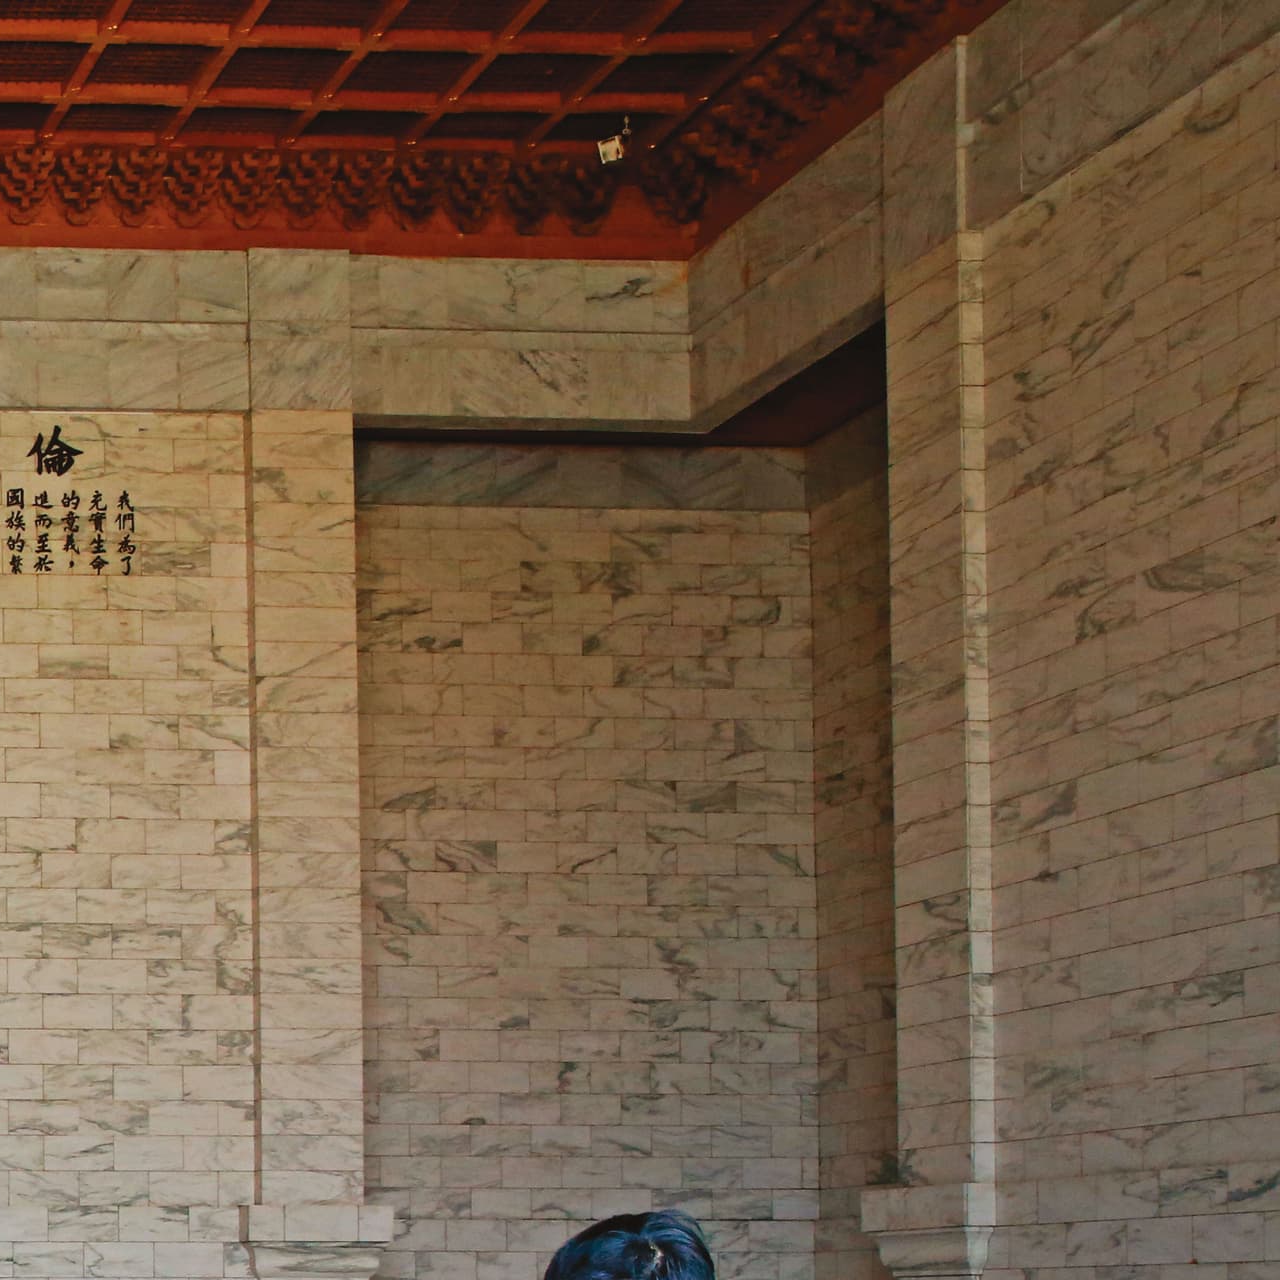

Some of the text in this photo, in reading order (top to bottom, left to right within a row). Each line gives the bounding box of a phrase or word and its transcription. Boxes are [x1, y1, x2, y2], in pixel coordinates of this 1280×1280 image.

[5, 487, 26, 575] 國族的繁
[31, 490, 55, 576] 進而至於
[87, 490, 110, 576] 充實生命
